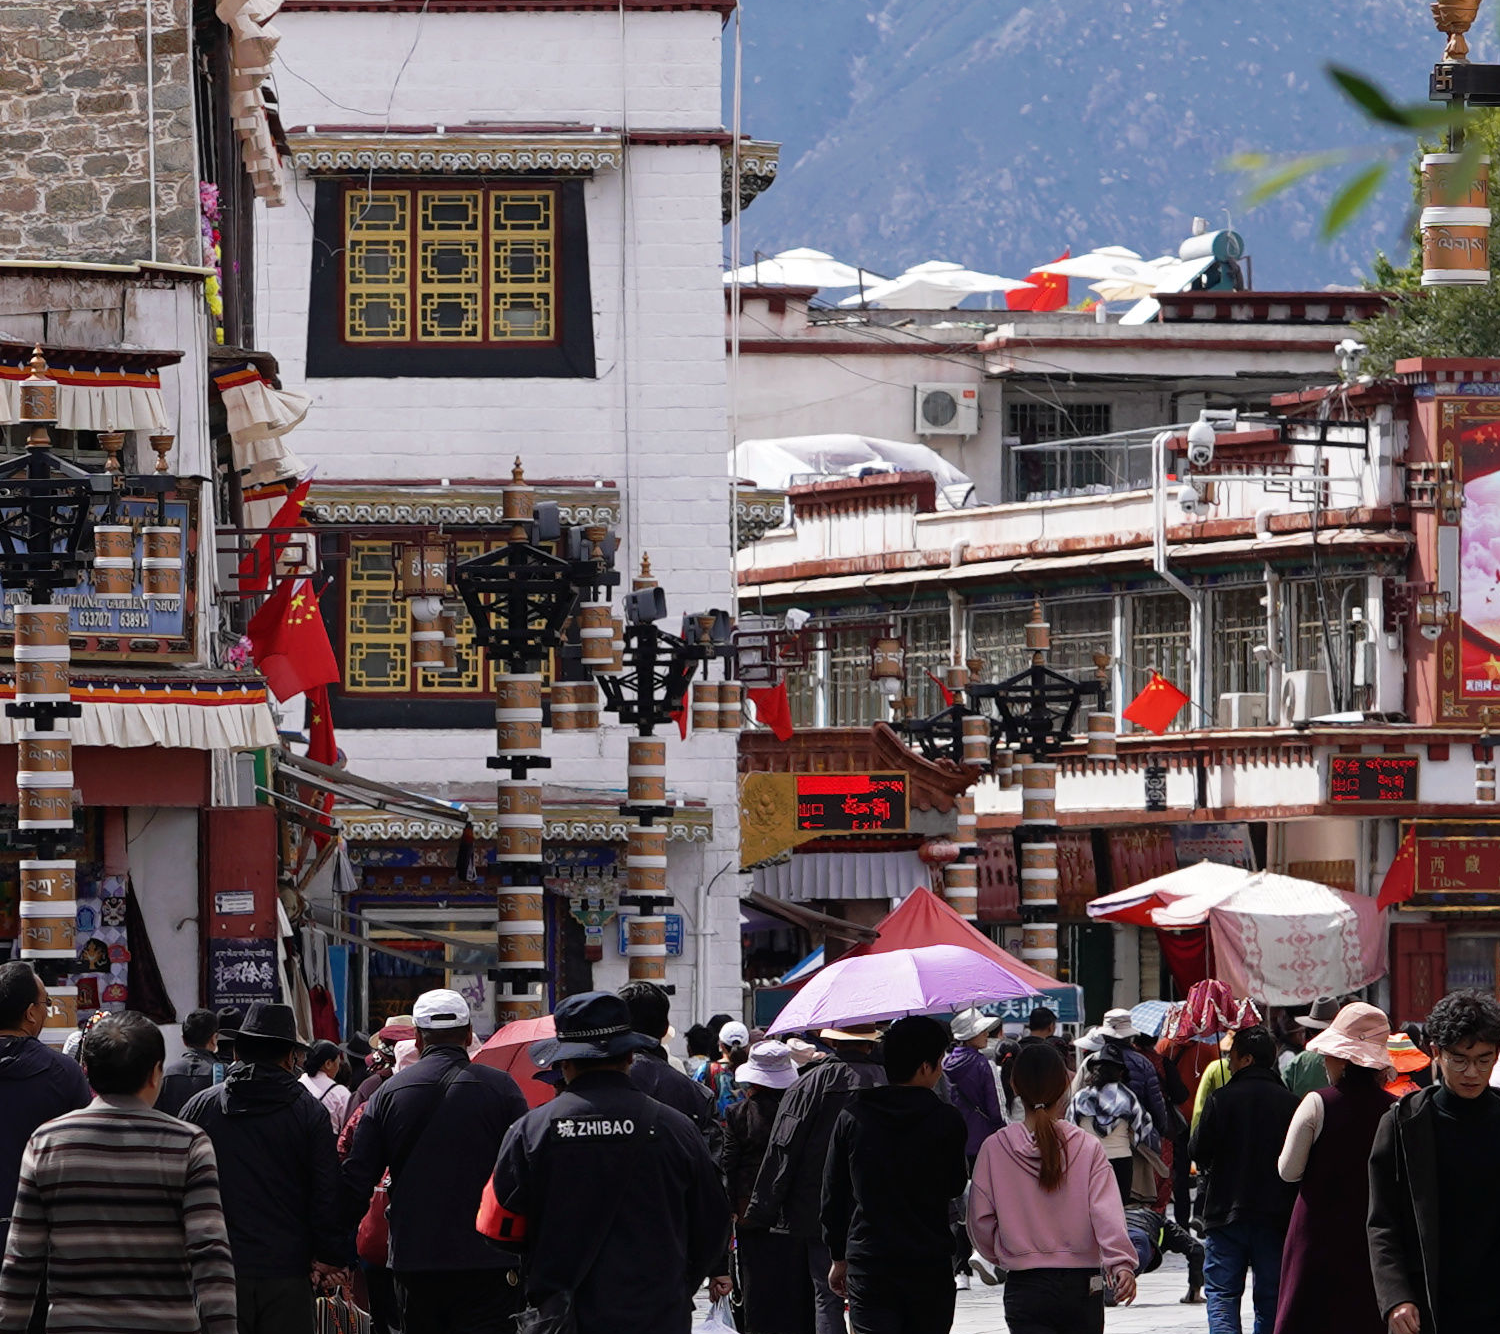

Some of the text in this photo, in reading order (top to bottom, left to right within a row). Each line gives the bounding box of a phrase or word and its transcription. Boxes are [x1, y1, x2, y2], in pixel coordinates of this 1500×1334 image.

[155, 599, 180, 612] SHOP
[1333, 758, 1360, 774] 安全
[1332, 777, 1360, 791] 出口
[799, 804, 824, 816] 出口
[852, 820, 882, 830] Exit
